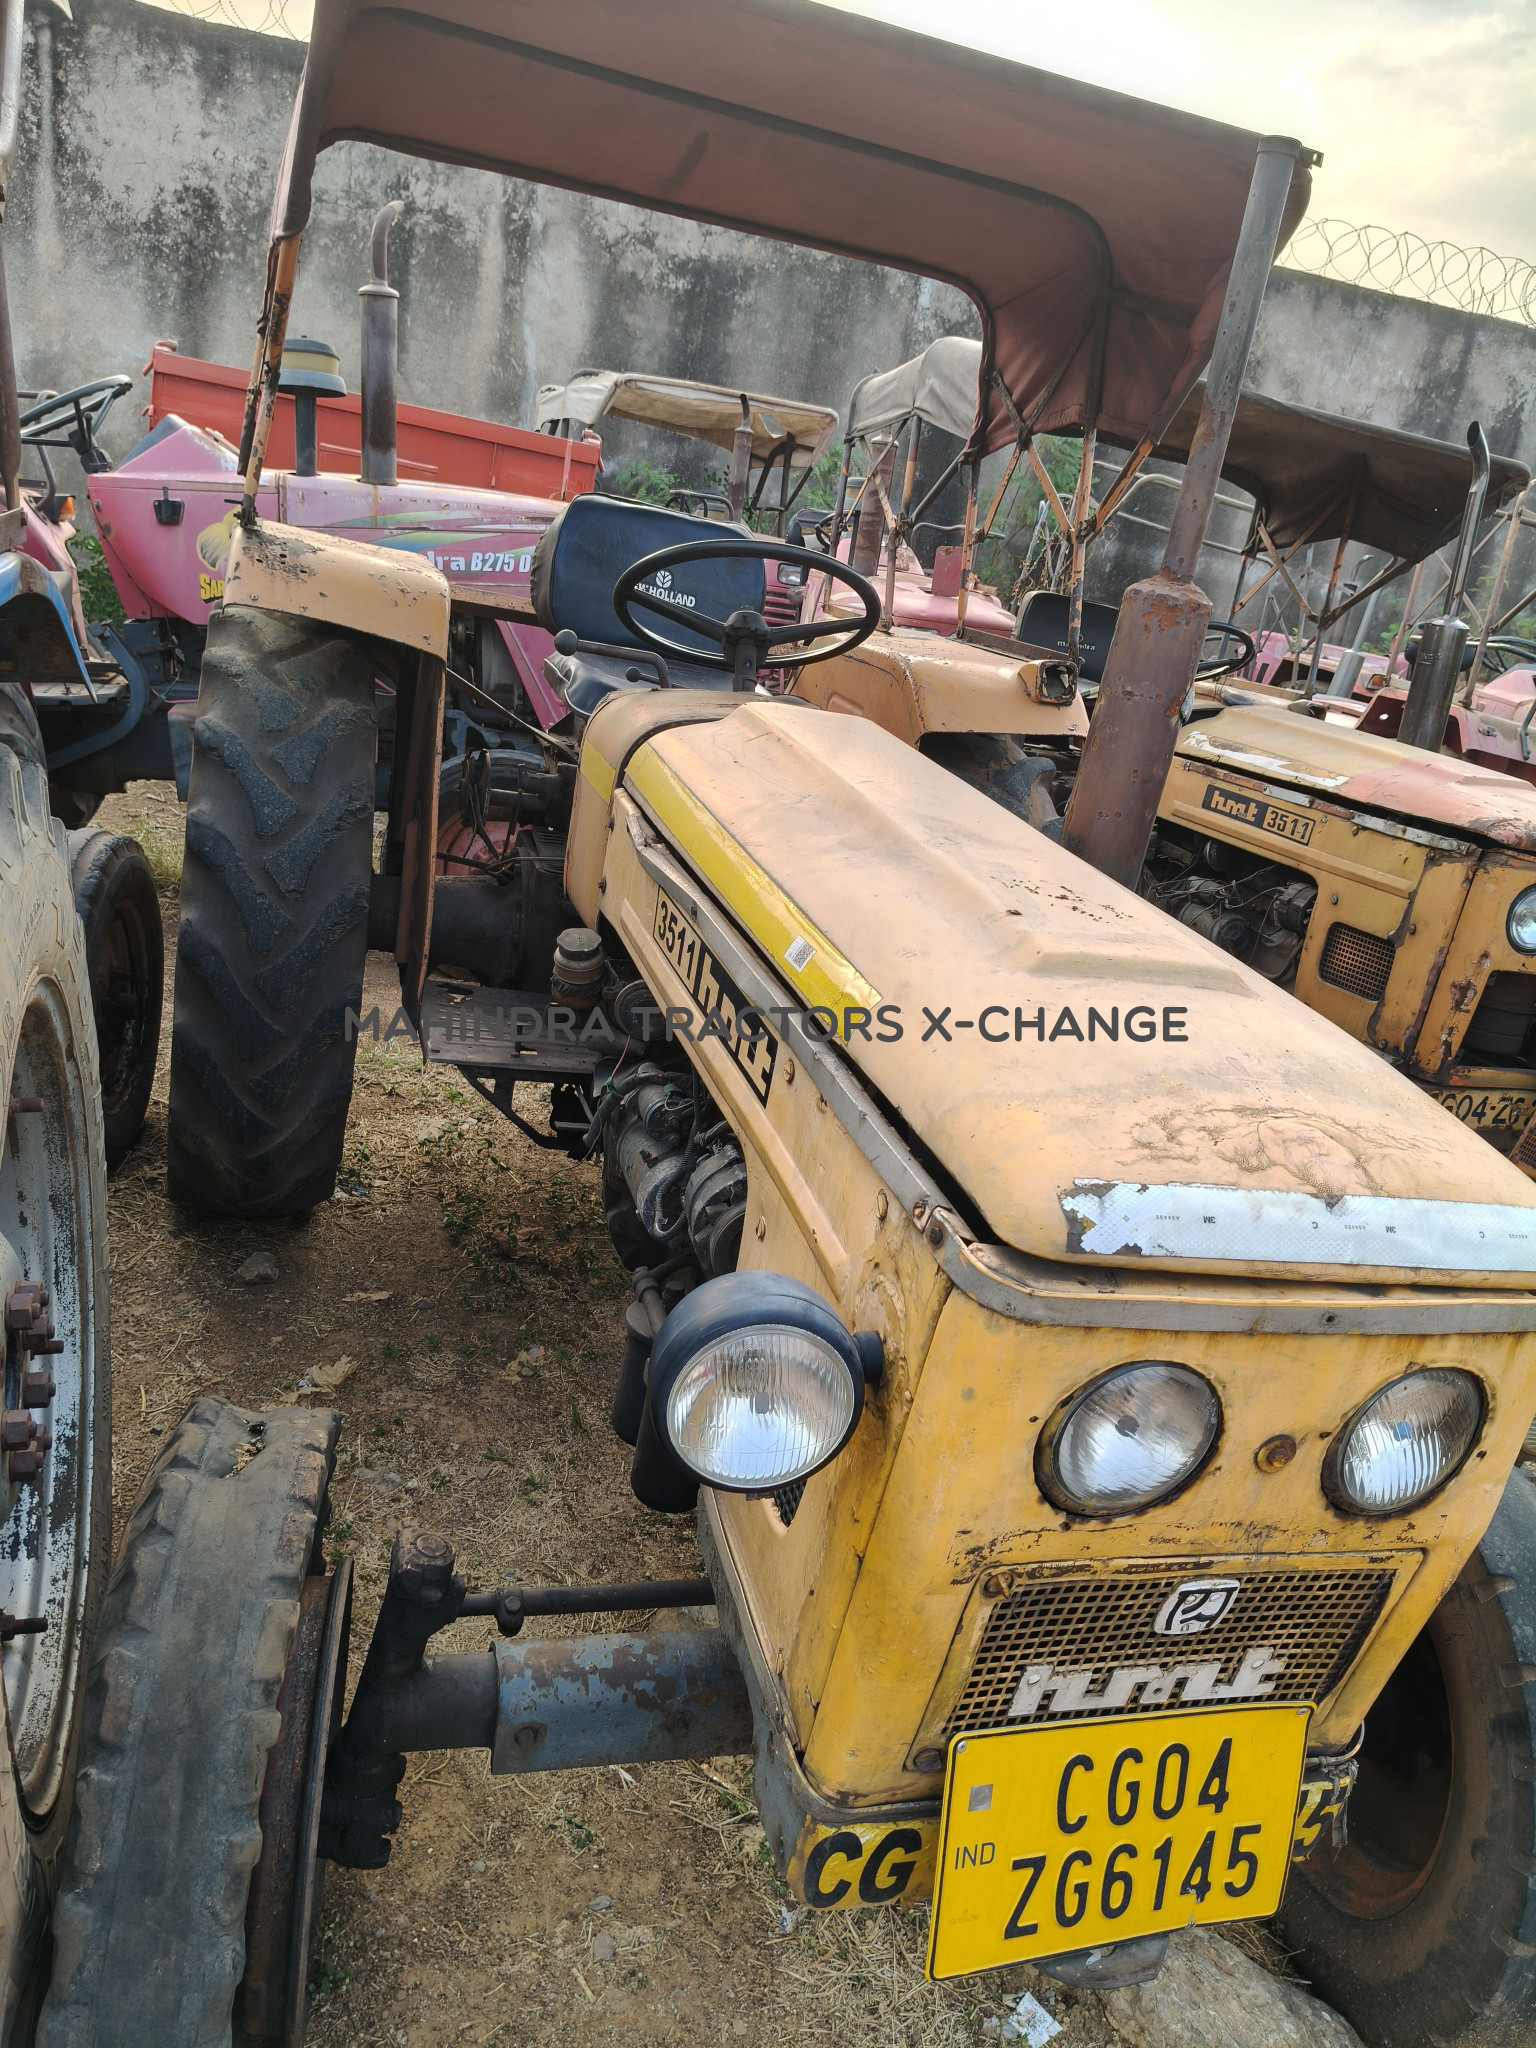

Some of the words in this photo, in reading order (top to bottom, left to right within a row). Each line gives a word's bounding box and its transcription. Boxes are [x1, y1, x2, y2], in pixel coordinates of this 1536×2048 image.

[470, 552, 515, 573] B275
[648, 585, 696, 608] HOLLAND
[1210, 789, 1258, 822] hmt
[1267, 810, 1310, 840] 3511
[657, 900, 696, 981] 3511
[1203, 1216, 1216, 1224] 3M
[1385, 1225, 1397, 1234] 3M
[1008, 1646, 1288, 1717] hmt
[1057, 1737, 1233, 1834] CG04
[803, 1829, 922, 1909] CG
[954, 1842, 996, 1870] IND
[1004, 1823, 1262, 1940] ZG6145
